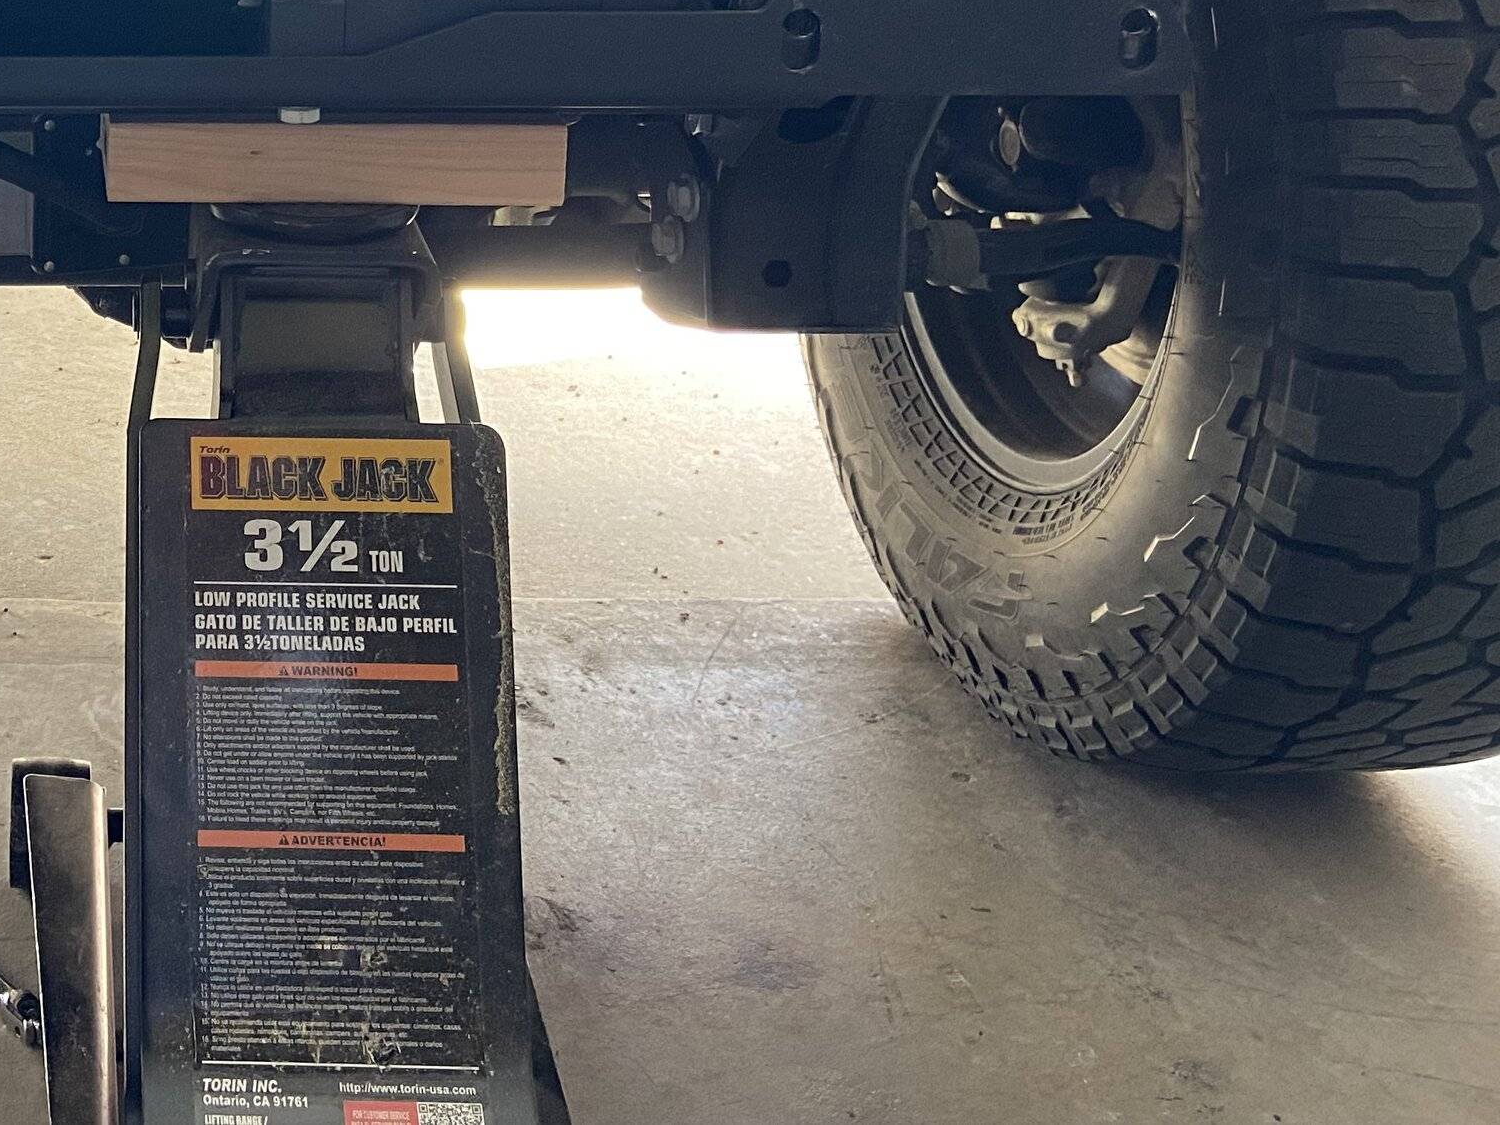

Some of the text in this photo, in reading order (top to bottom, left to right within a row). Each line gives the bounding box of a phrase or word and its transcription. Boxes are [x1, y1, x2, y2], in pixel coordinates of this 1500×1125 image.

[199, 445, 230, 454] Torin
[200, 455, 439, 503] BLACK JACK
[368, 550, 404, 573] TON
[194, 591, 420, 610] LOW PROFILE SERVICE JACK
[194, 613, 458, 634] GATO DE TALLER DE BAJO PERFIL
[194, 633, 239, 649] PARA
[292, 665, 359, 677] WARNING!
[292, 834, 386, 847] ADVERTENCIA!
[202, 1078, 282, 1093] TORIN INC.
[339, 1081, 477, 1096] http://www.torin-usa.com
[202, 1094, 309, 1109] Ontario, CA 91761
